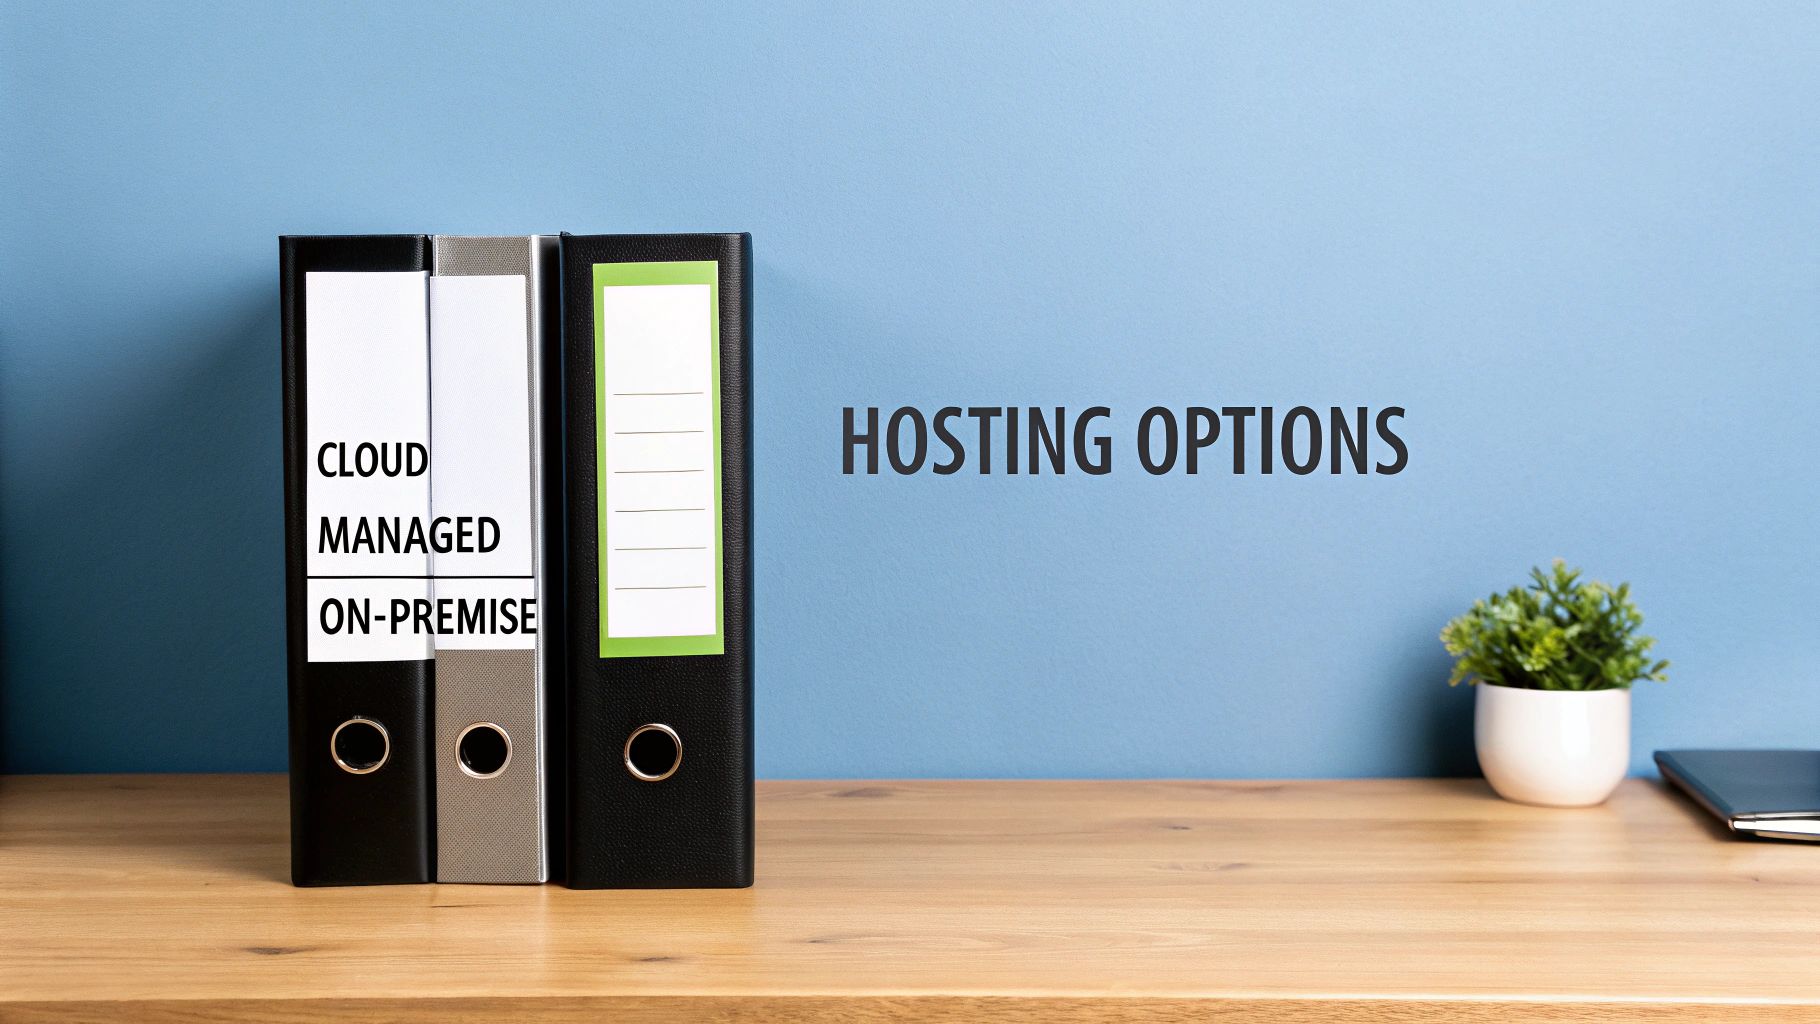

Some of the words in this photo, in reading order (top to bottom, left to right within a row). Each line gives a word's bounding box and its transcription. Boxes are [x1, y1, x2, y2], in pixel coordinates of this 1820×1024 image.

[317, 441, 429, 478] CLOUD
[318, 516, 501, 554] MANAGED
[319, 597, 538, 635] ON-PREMISE
